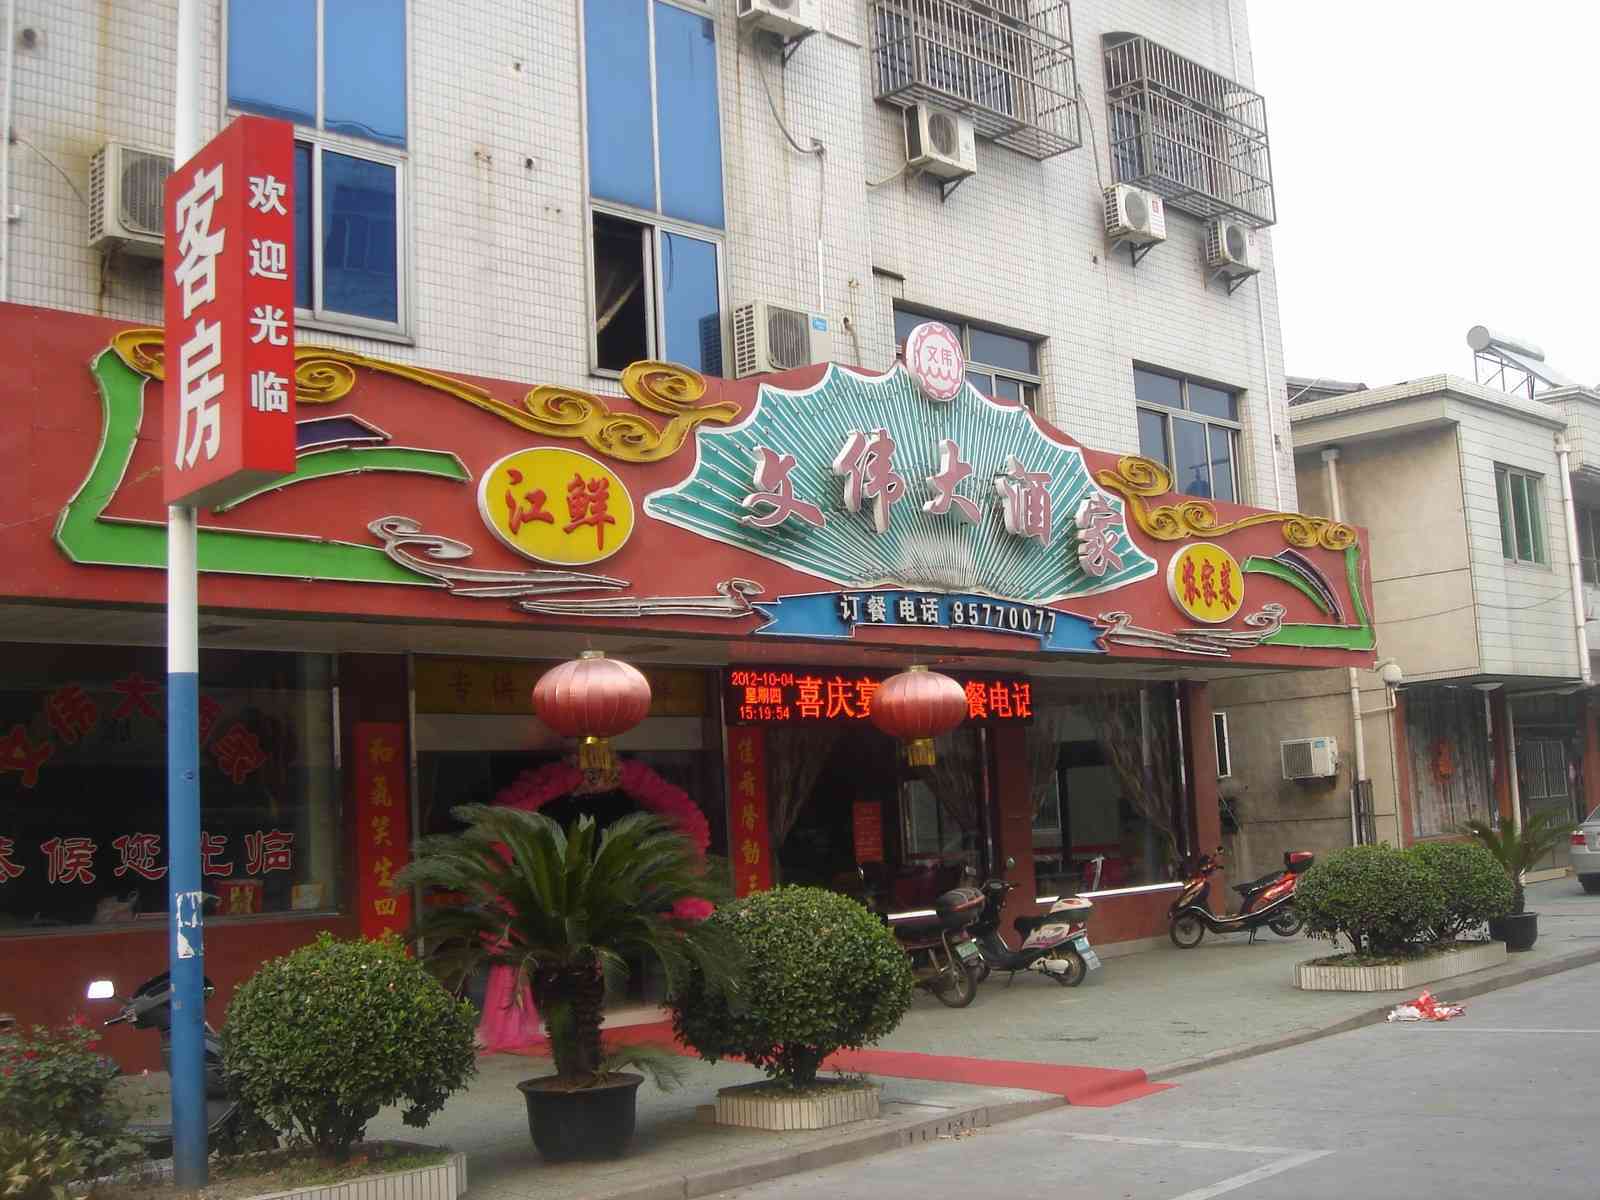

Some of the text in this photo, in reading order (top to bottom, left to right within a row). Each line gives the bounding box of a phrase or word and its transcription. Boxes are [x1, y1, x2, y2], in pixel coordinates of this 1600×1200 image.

[174, 162, 226, 471] 客房
[248, 174, 289, 414] 欢迎光临
[505, 467, 616, 551] 江鲜
[742, 427, 1125, 577] 文伟大酒家
[840, 593, 1057, 634] 订餐电话 85770077
[731, 671, 794, 687] 2012-10-04
[744, 687, 782, 704] 星期四
[739, 705, 790, 721] 15:19:54
